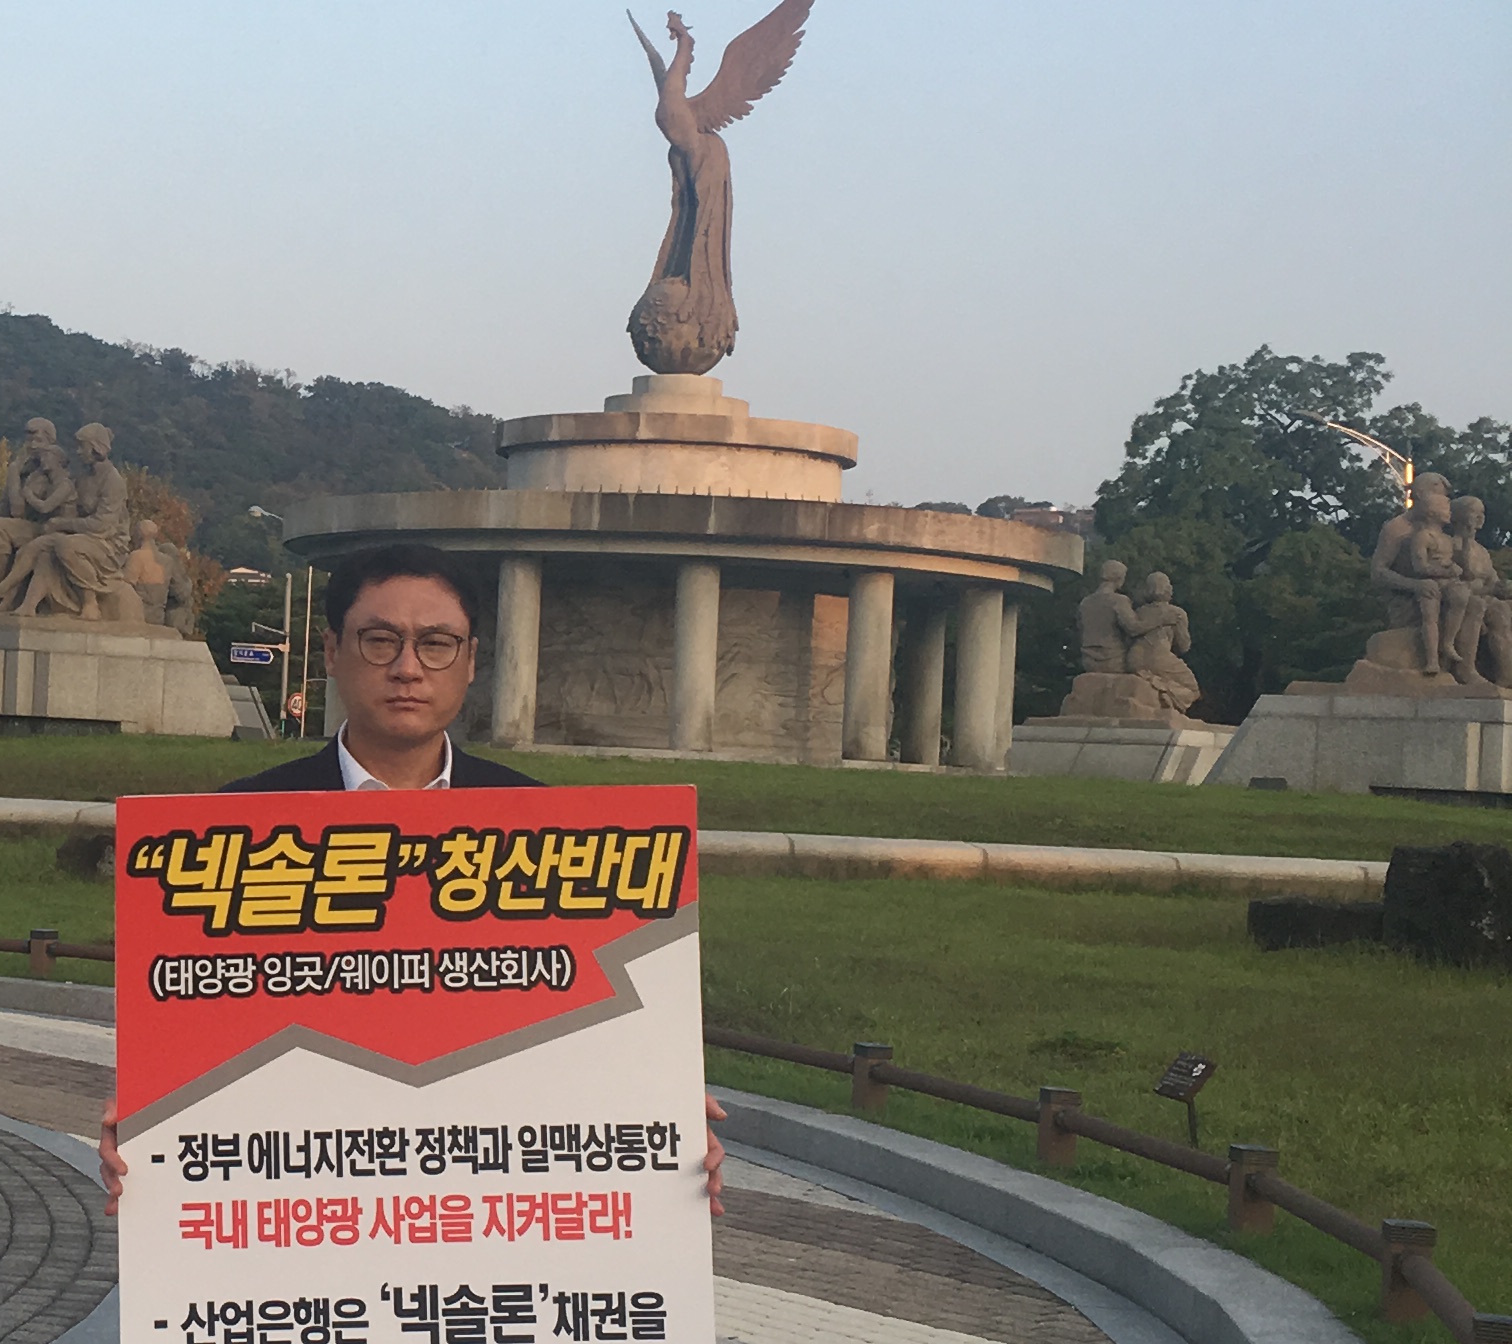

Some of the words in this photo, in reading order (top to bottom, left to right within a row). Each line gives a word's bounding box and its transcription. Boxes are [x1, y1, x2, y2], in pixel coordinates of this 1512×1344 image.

[435, 832, 683, 912] 청산반대
[153, 957, 257, 997] (태양광
[264, 952, 430, 992] 잉곳/웨이퍼
[439, 949, 571, 988] 생산회사)
[177, 1132, 243, 1182] 정부
[247, 1126, 410, 1180] 에너지전환
[415, 1124, 513, 1176] 정책과
[517, 1121, 681, 1173] 일맥상통한
[178, 1199, 249, 1250] 국내
[256, 1196, 363, 1248] 태양광
[369, 1194, 474, 1245] 사업을
[482, 1191, 633, 1242] 지켜달라!
